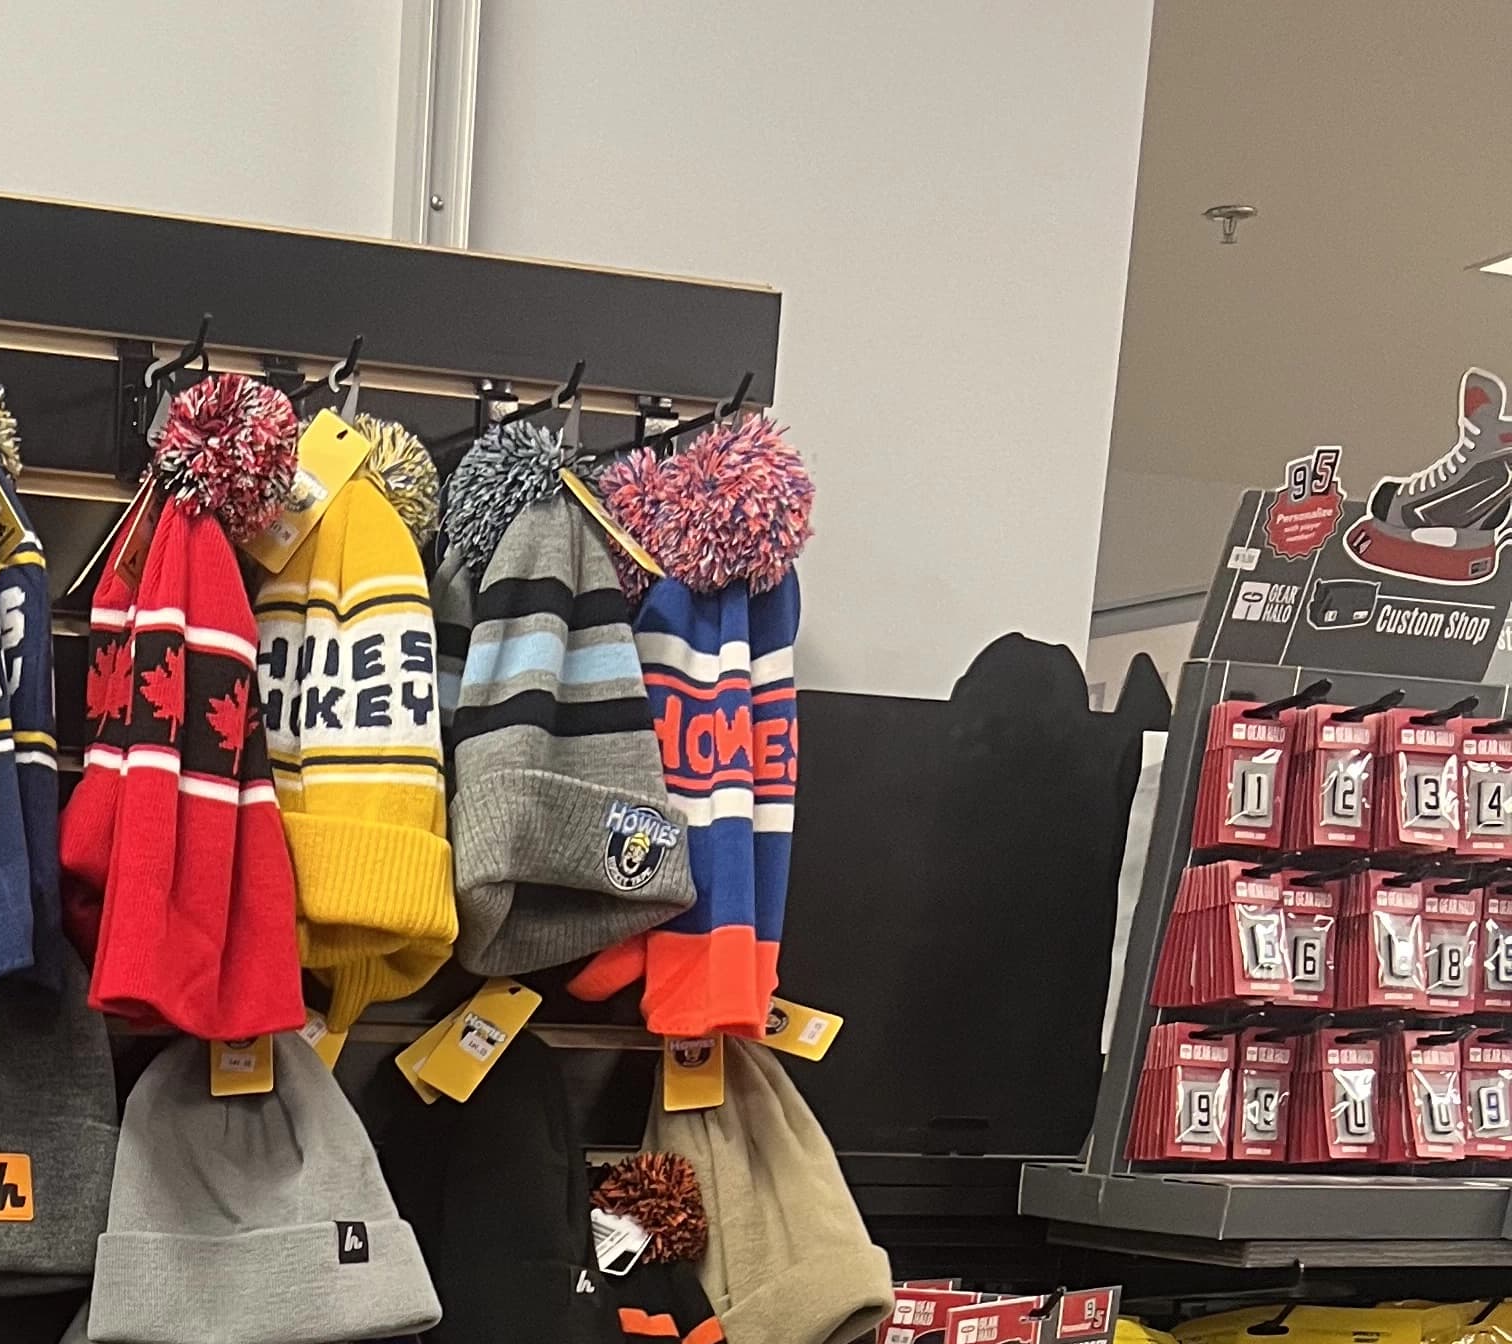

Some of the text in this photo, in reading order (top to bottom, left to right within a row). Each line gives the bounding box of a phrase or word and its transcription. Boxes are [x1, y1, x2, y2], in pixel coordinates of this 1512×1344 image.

[1289, 446, 1341, 502] 95
[1270, 584, 1298, 604] GEAR
[1262, 603, 1293, 622] HALO
[1375, 604, 1491, 645] Custom Shop
[1342, 776, 1355, 809] 2
[1424, 777, 1440, 809] 3
[1486, 784, 1501, 816] 4
[606, 799, 681, 848] HOWIES
[1304, 944, 1317, 974] 6
[1448, 947, 1461, 979] 8
[1196, 1094, 1210, 1127] 9
